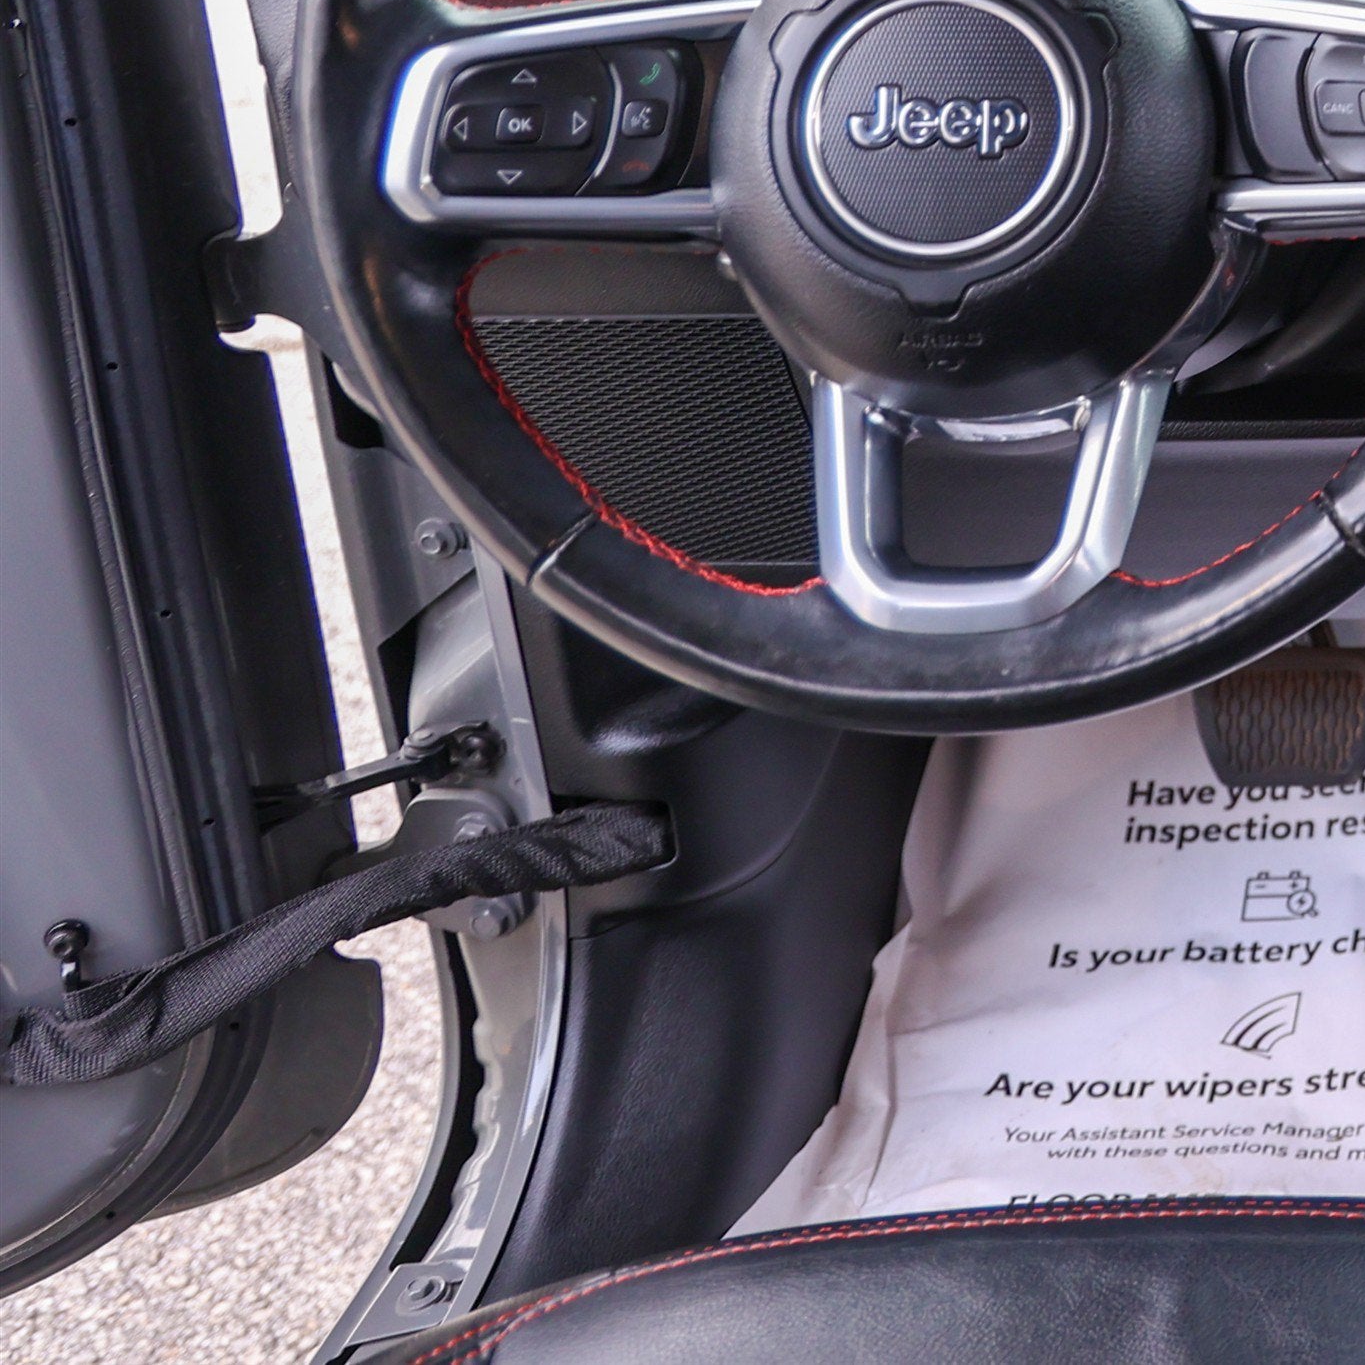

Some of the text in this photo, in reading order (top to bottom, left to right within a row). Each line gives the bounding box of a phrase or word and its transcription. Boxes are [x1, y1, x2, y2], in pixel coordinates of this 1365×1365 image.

[507, 116, 533, 133] OK
[847, 83, 1030, 159] Jeep
[1127, 779, 1217, 807] Have
[1123, 815, 1315, 850] inspection
[1048, 943, 1079, 969] Is
[1085, 946, 1176, 974] your
[1183, 939, 1322, 966] battery
[983, 1072, 1054, 1100] Are
[1060, 1075, 1155, 1106] your
[1165, 1071, 1294, 1104] wipers
[1003, 1126, 1057, 1146] Your
[1060, 1123, 1167, 1142] Assistant
[1172, 1122, 1256, 1139] Service
[1261, 1119, 1365, 1144] Manager
[1046, 1143, 1097, 1161] with
[1103, 1143, 1168, 1159] these
[1174, 1141, 1289, 1160] questions
[1295, 1142, 1341, 1161] and
